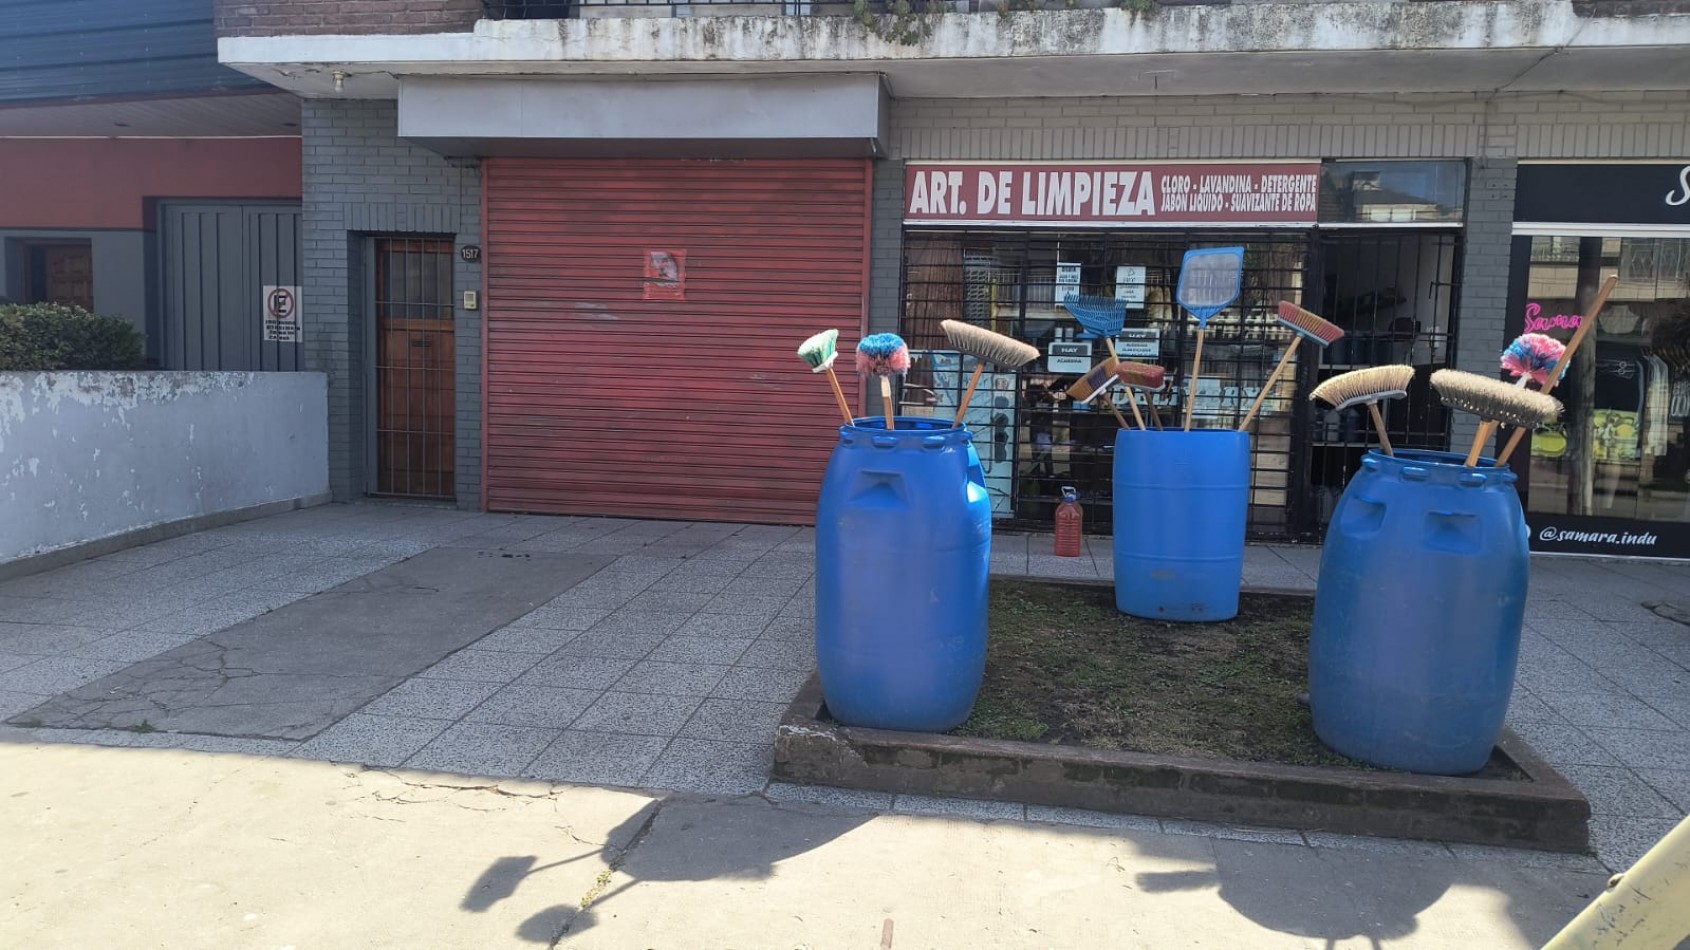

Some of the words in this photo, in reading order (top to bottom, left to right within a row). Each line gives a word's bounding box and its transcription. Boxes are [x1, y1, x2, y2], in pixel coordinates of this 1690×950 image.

[910, 170, 967, 215] ART.
[977, 170, 1014, 215] DE
[1021, 170, 1156, 216] LIMPIEZA
[1161, 175, 1191, 193] CLORO
[1200, 175, 1252, 193] LAVANDINA
[1261, 175, 1317, 193] DETERGENTE
[1161, 193, 1188, 212] JABON
[1189, 193, 1223, 212] LIQUIDO
[1231, 193, 1280, 212] SUAVIZANTE
[1281, 193, 1293, 212] DE
[1294, 193, 1316, 212] ROPA
[462, 248, 479, 259] 1517
[1539, 526, 1657, 546] @samara.indu
